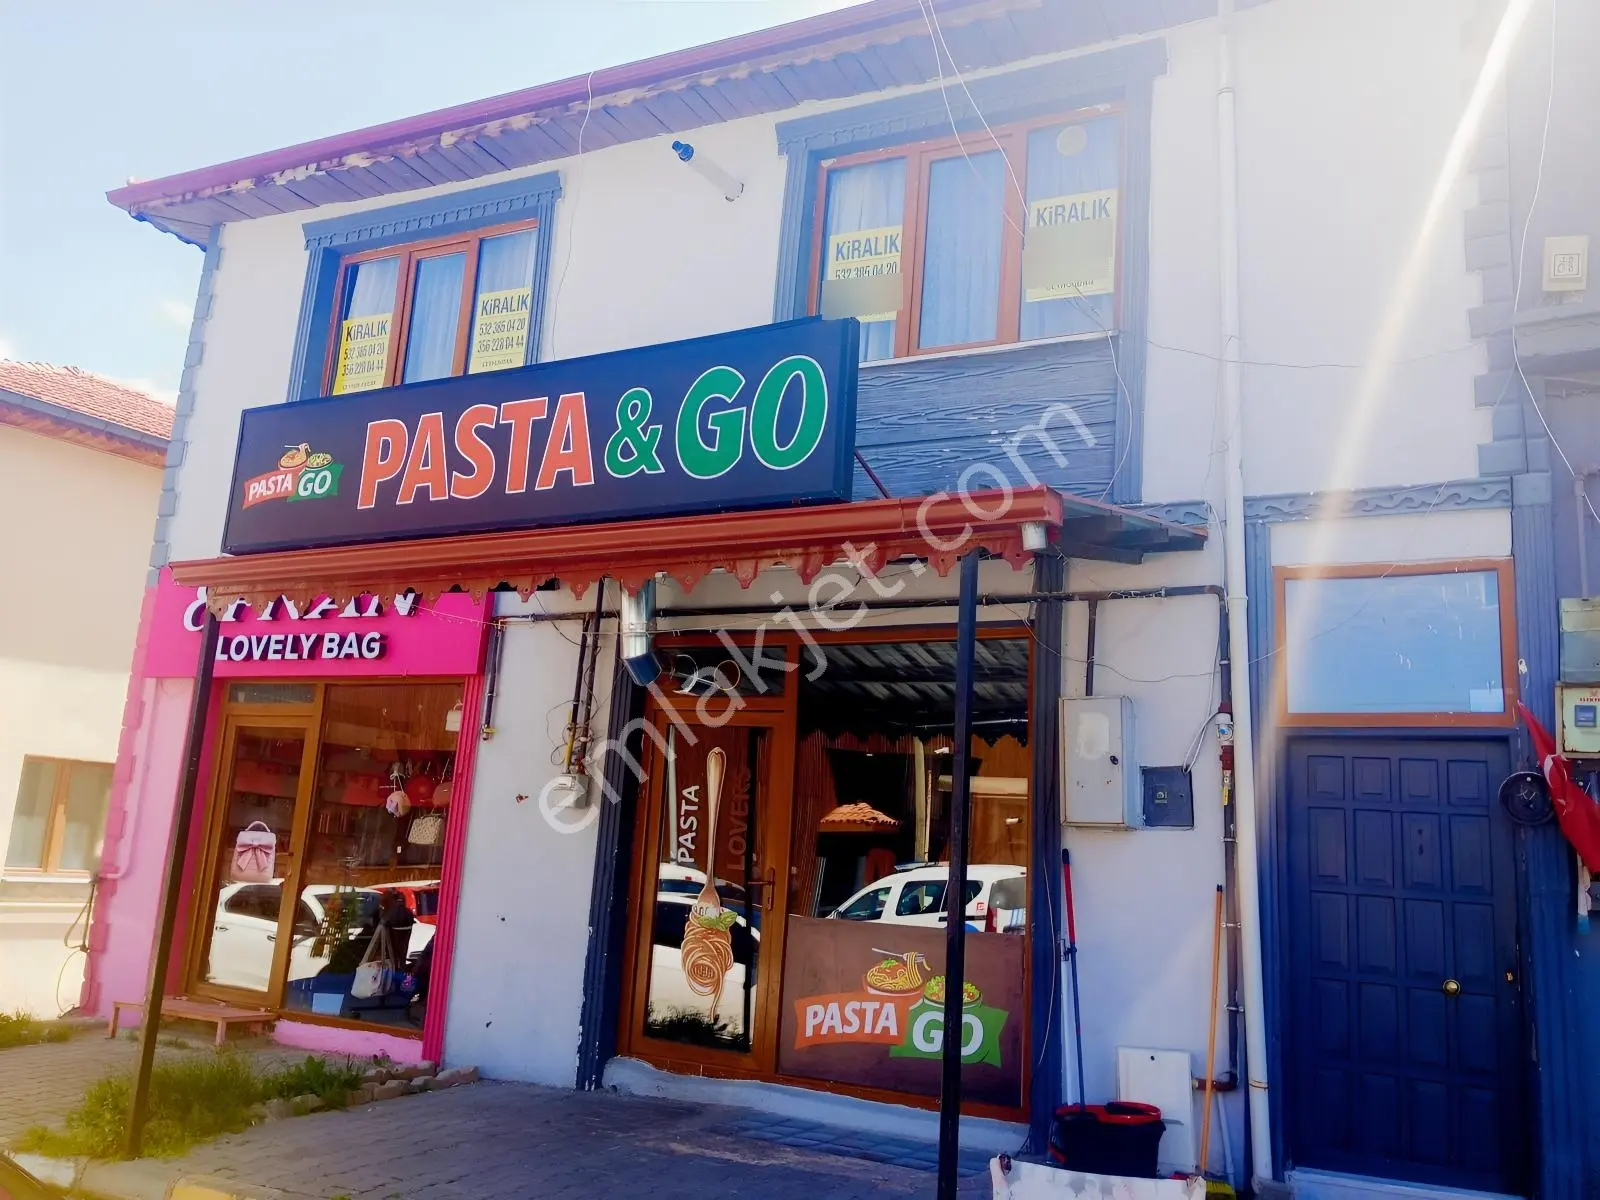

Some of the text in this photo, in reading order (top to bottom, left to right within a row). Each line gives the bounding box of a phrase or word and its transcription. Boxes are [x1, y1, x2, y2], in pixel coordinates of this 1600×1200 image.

[479, 322, 493, 336] 532
[516, 317, 526, 331] 20
[357, 354, 828, 510] PASTA & GO
[248, 470, 332, 502] PASTA GO
[216, 631, 381, 661] LOVELY BAG
[677, 785, 701, 863] PASTA
[805, 1001, 984, 1056] PASTA GO
